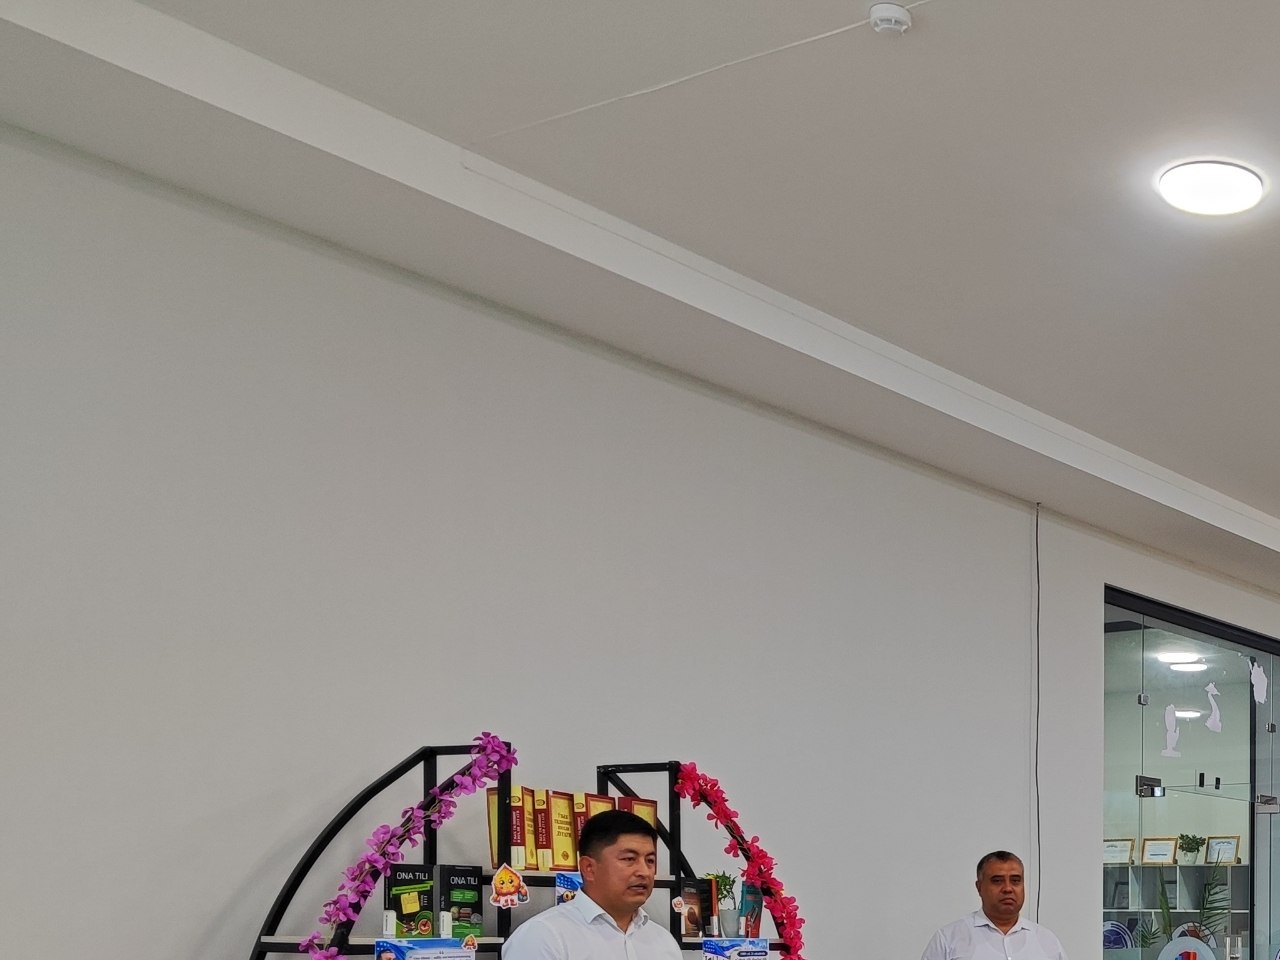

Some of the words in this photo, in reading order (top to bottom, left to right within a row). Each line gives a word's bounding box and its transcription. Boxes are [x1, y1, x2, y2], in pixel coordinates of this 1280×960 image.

[396, 872, 414, 880] ONA
[415, 872, 428, 880] TILI
[450, 876, 467, 884] ONA
[467, 877, 478, 885] TILI
